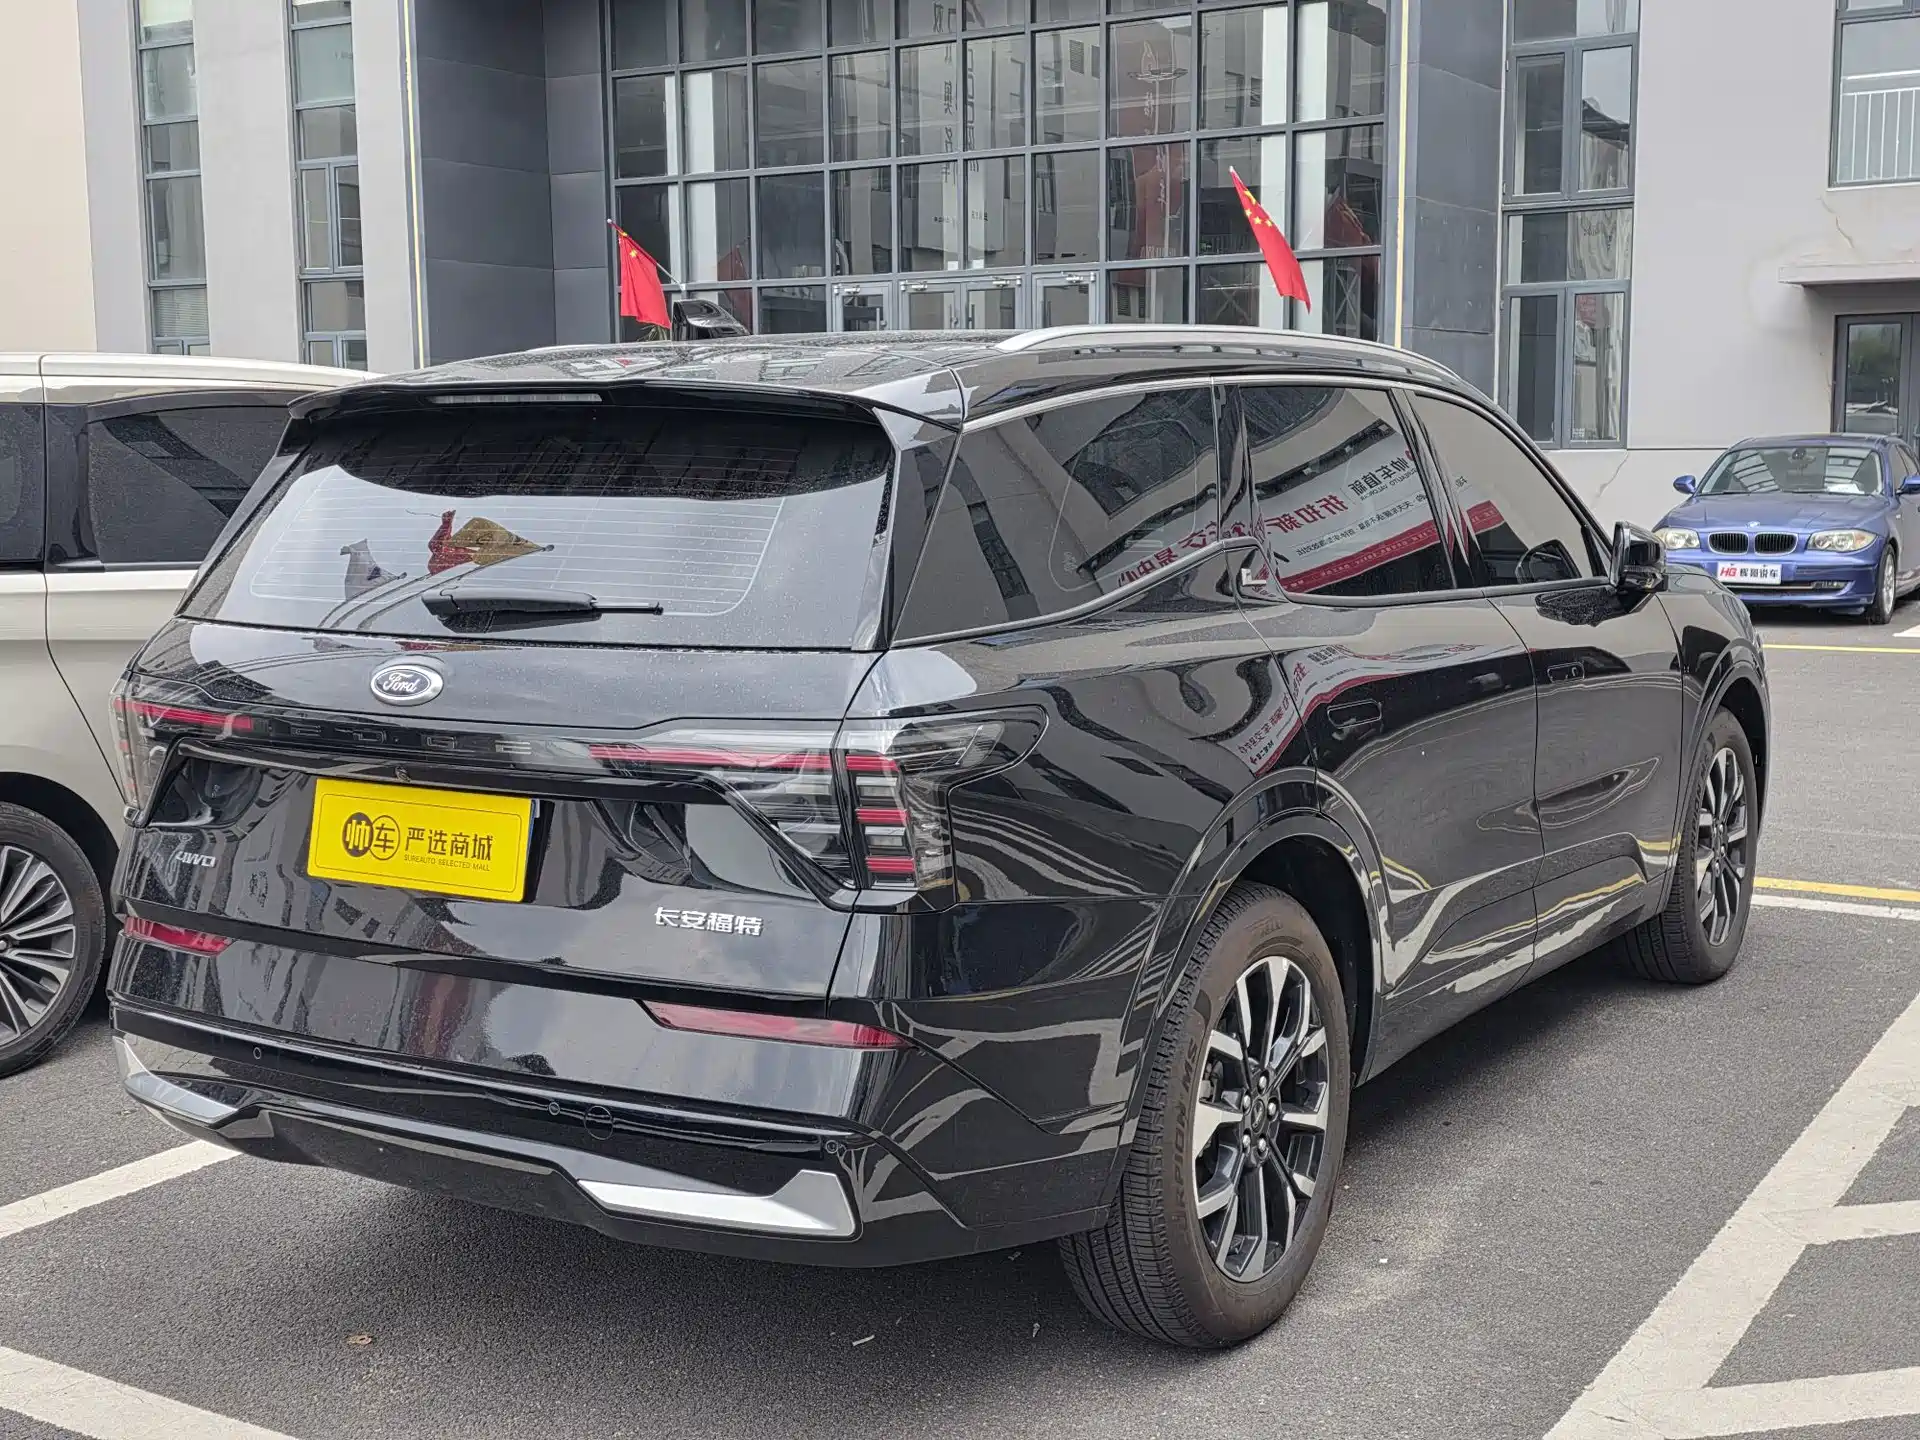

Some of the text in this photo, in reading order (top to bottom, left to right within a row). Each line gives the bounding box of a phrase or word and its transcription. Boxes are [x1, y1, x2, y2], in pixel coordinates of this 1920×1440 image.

[381, 672, 419, 693] Ford
[405, 826, 493, 861] 严选商城
[404, 853, 491, 872] SUREAUTO SELECTED MALL
[655, 906, 762, 936] 长安福特
